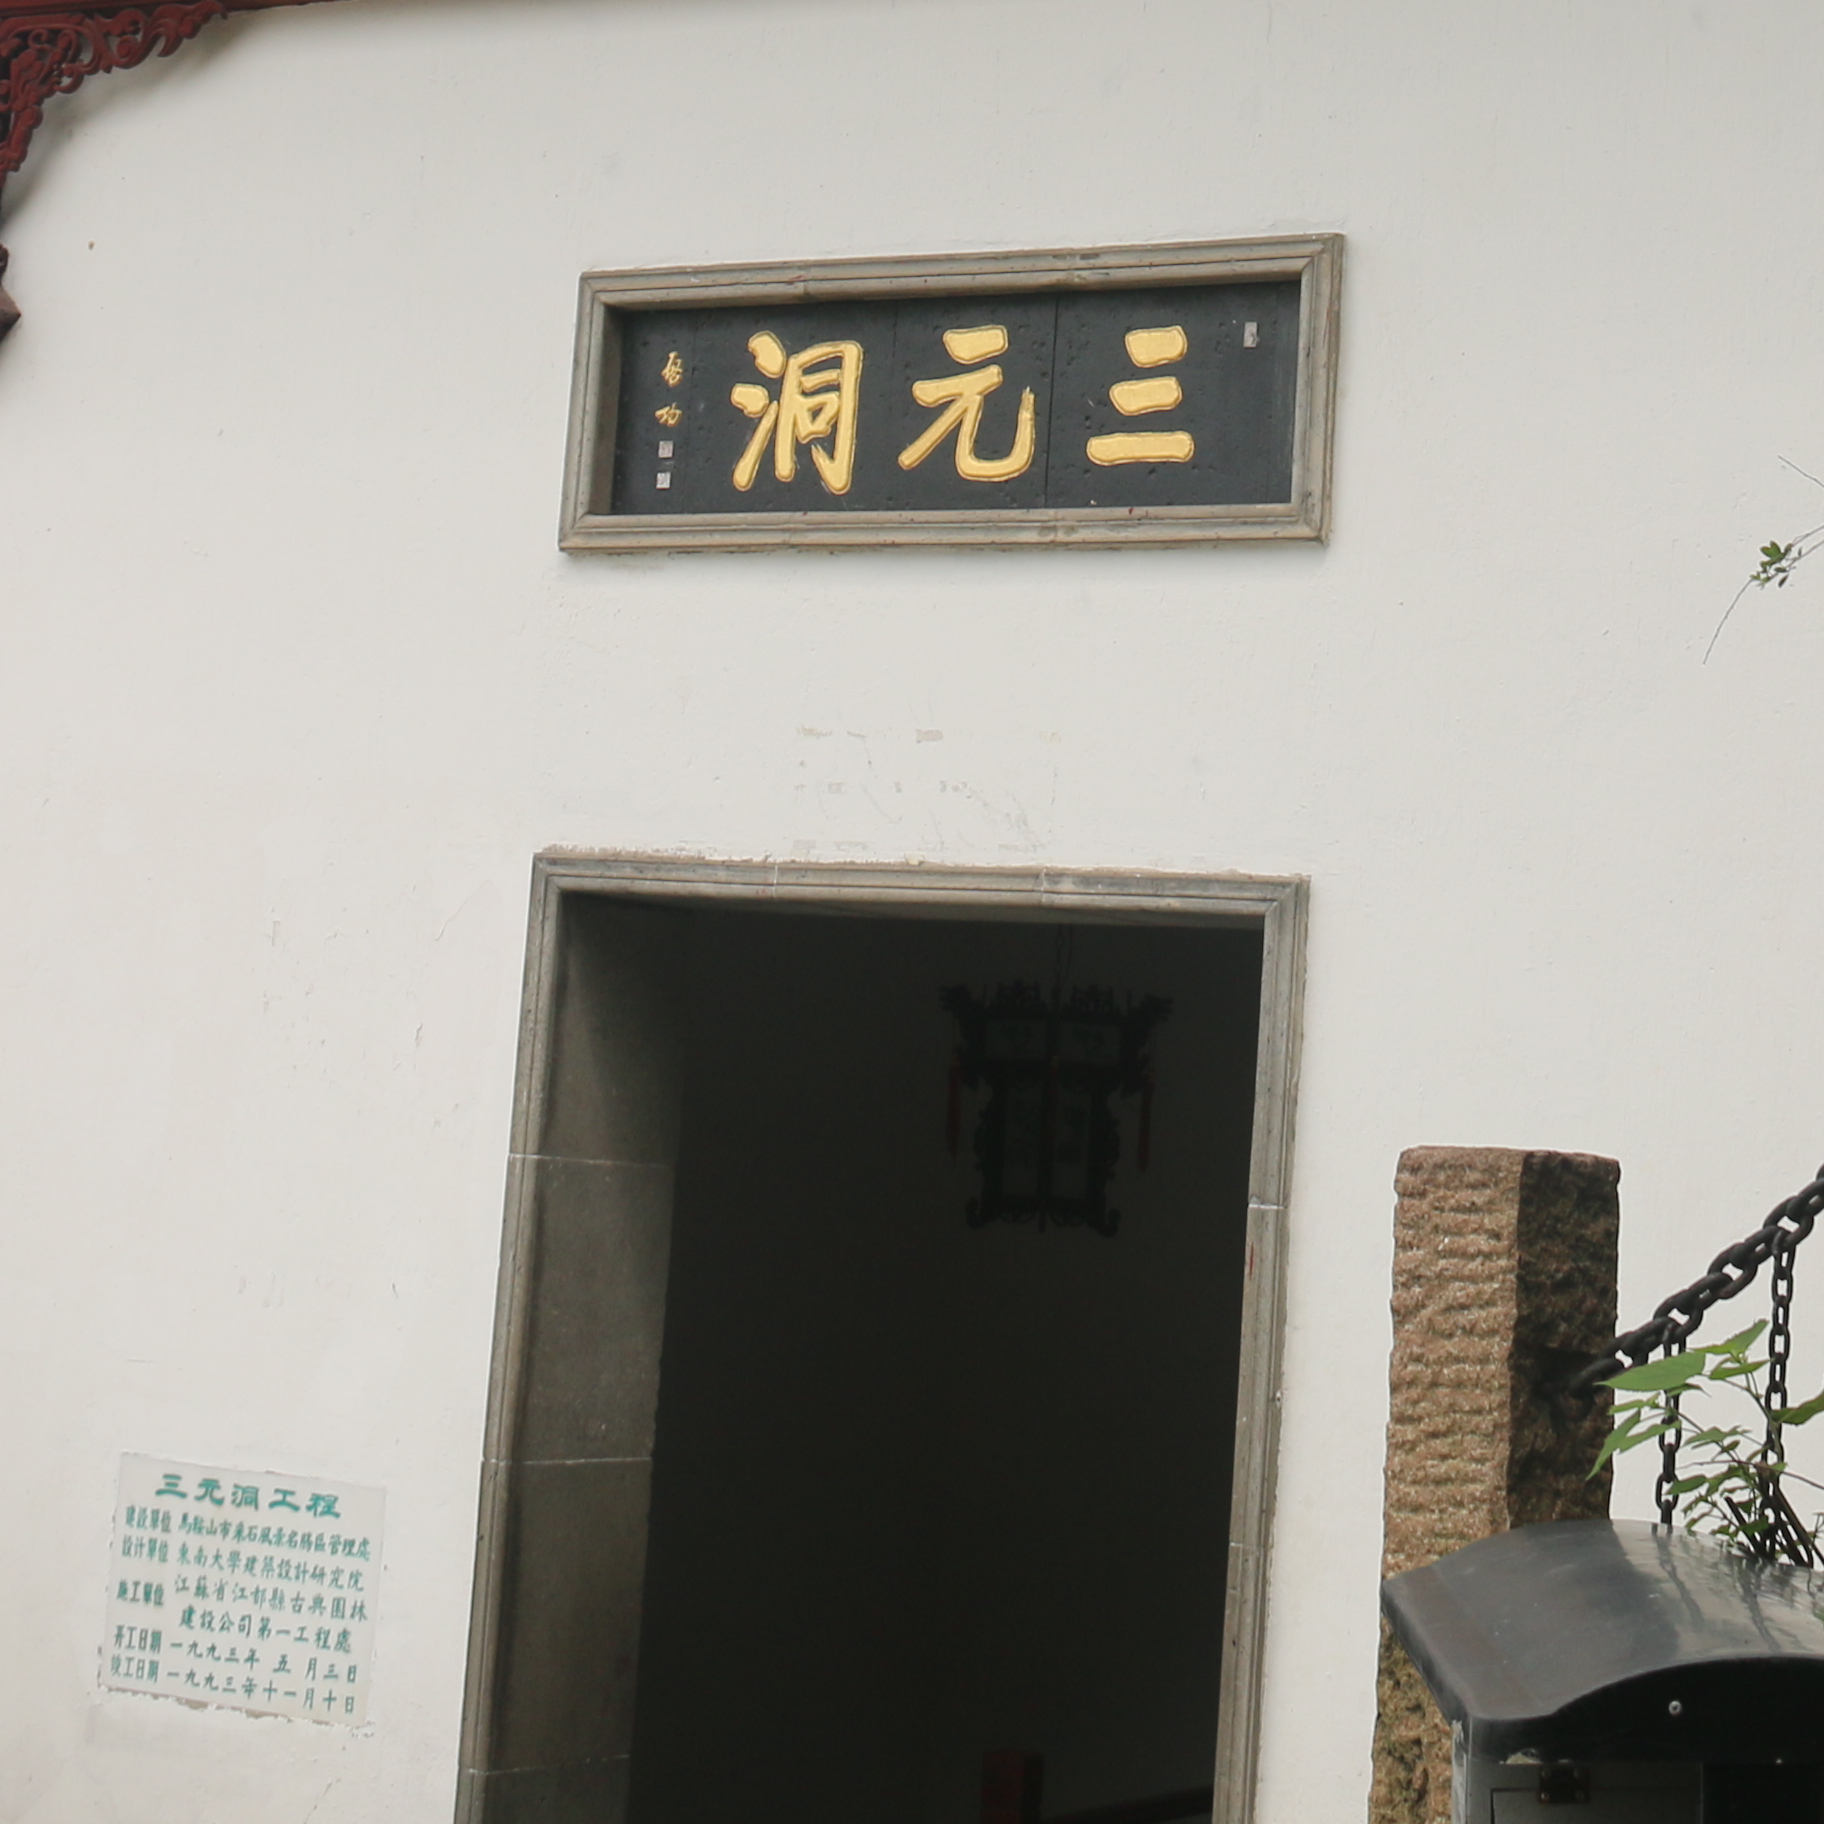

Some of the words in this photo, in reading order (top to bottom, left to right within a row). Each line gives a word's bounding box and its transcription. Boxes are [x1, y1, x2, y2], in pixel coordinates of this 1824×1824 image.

[155, 1473, 342, 1519] 三元洞工程
